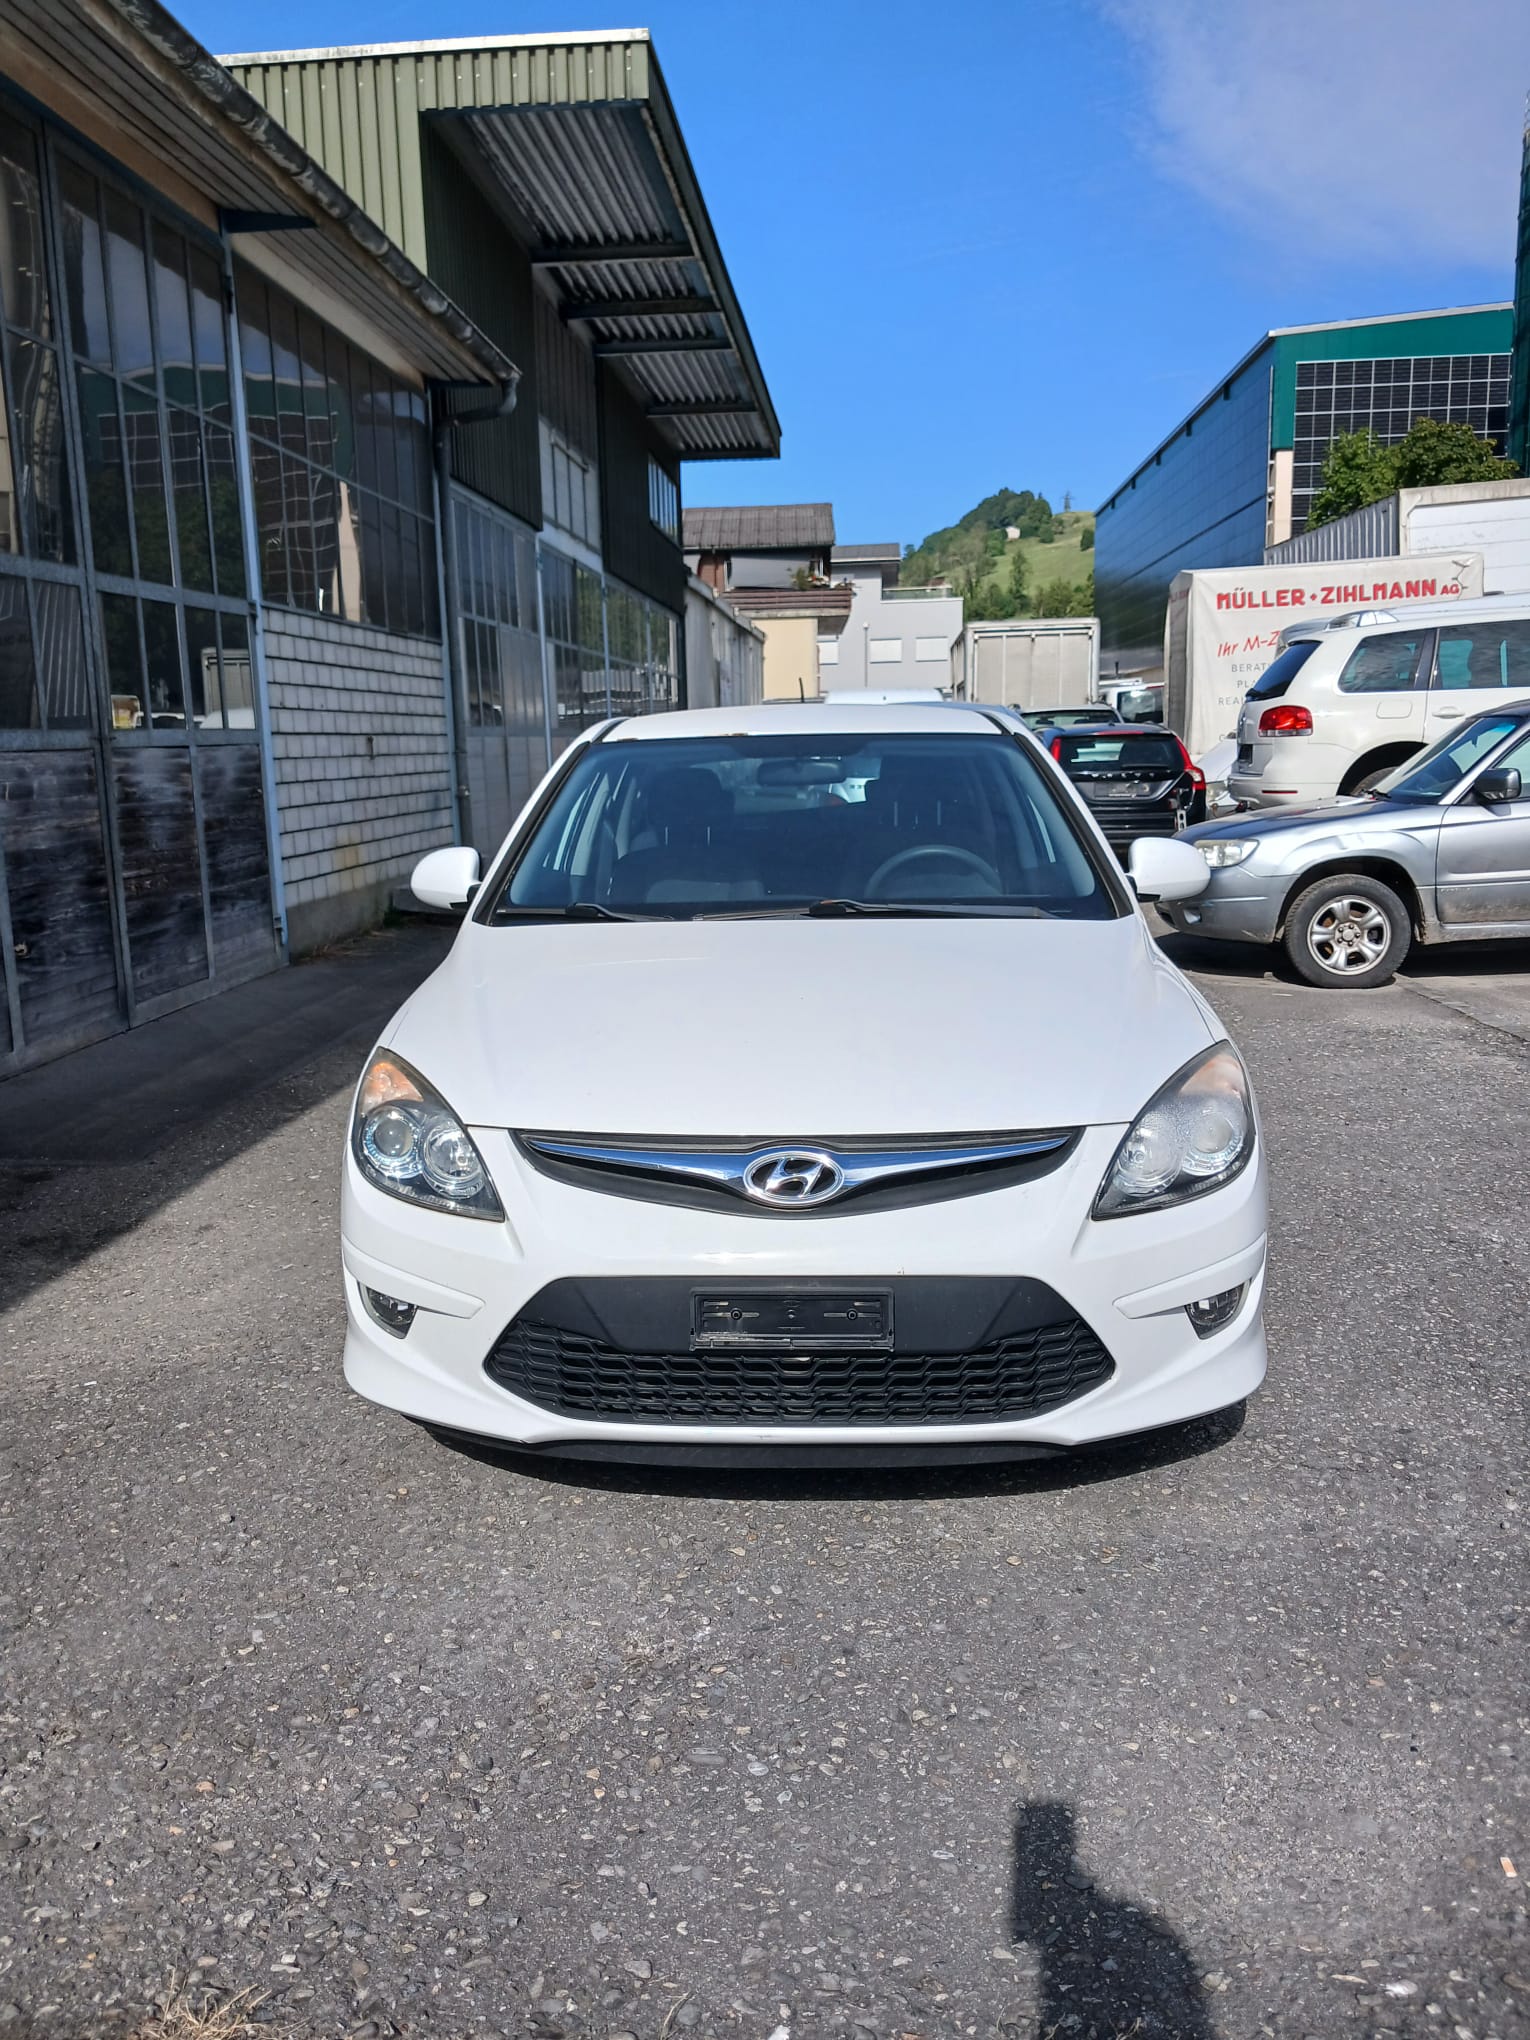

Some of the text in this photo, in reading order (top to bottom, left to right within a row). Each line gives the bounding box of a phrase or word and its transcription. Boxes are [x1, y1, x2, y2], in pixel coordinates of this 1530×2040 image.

[1216, 587, 1306, 610] MÜLLER
[1320, 578, 1437, 605] ZIHLMANN
[1440, 583, 1460, 596] AG
[1217, 641, 1239, 657] Ihr
[1231, 662, 1270, 673] BERAT
